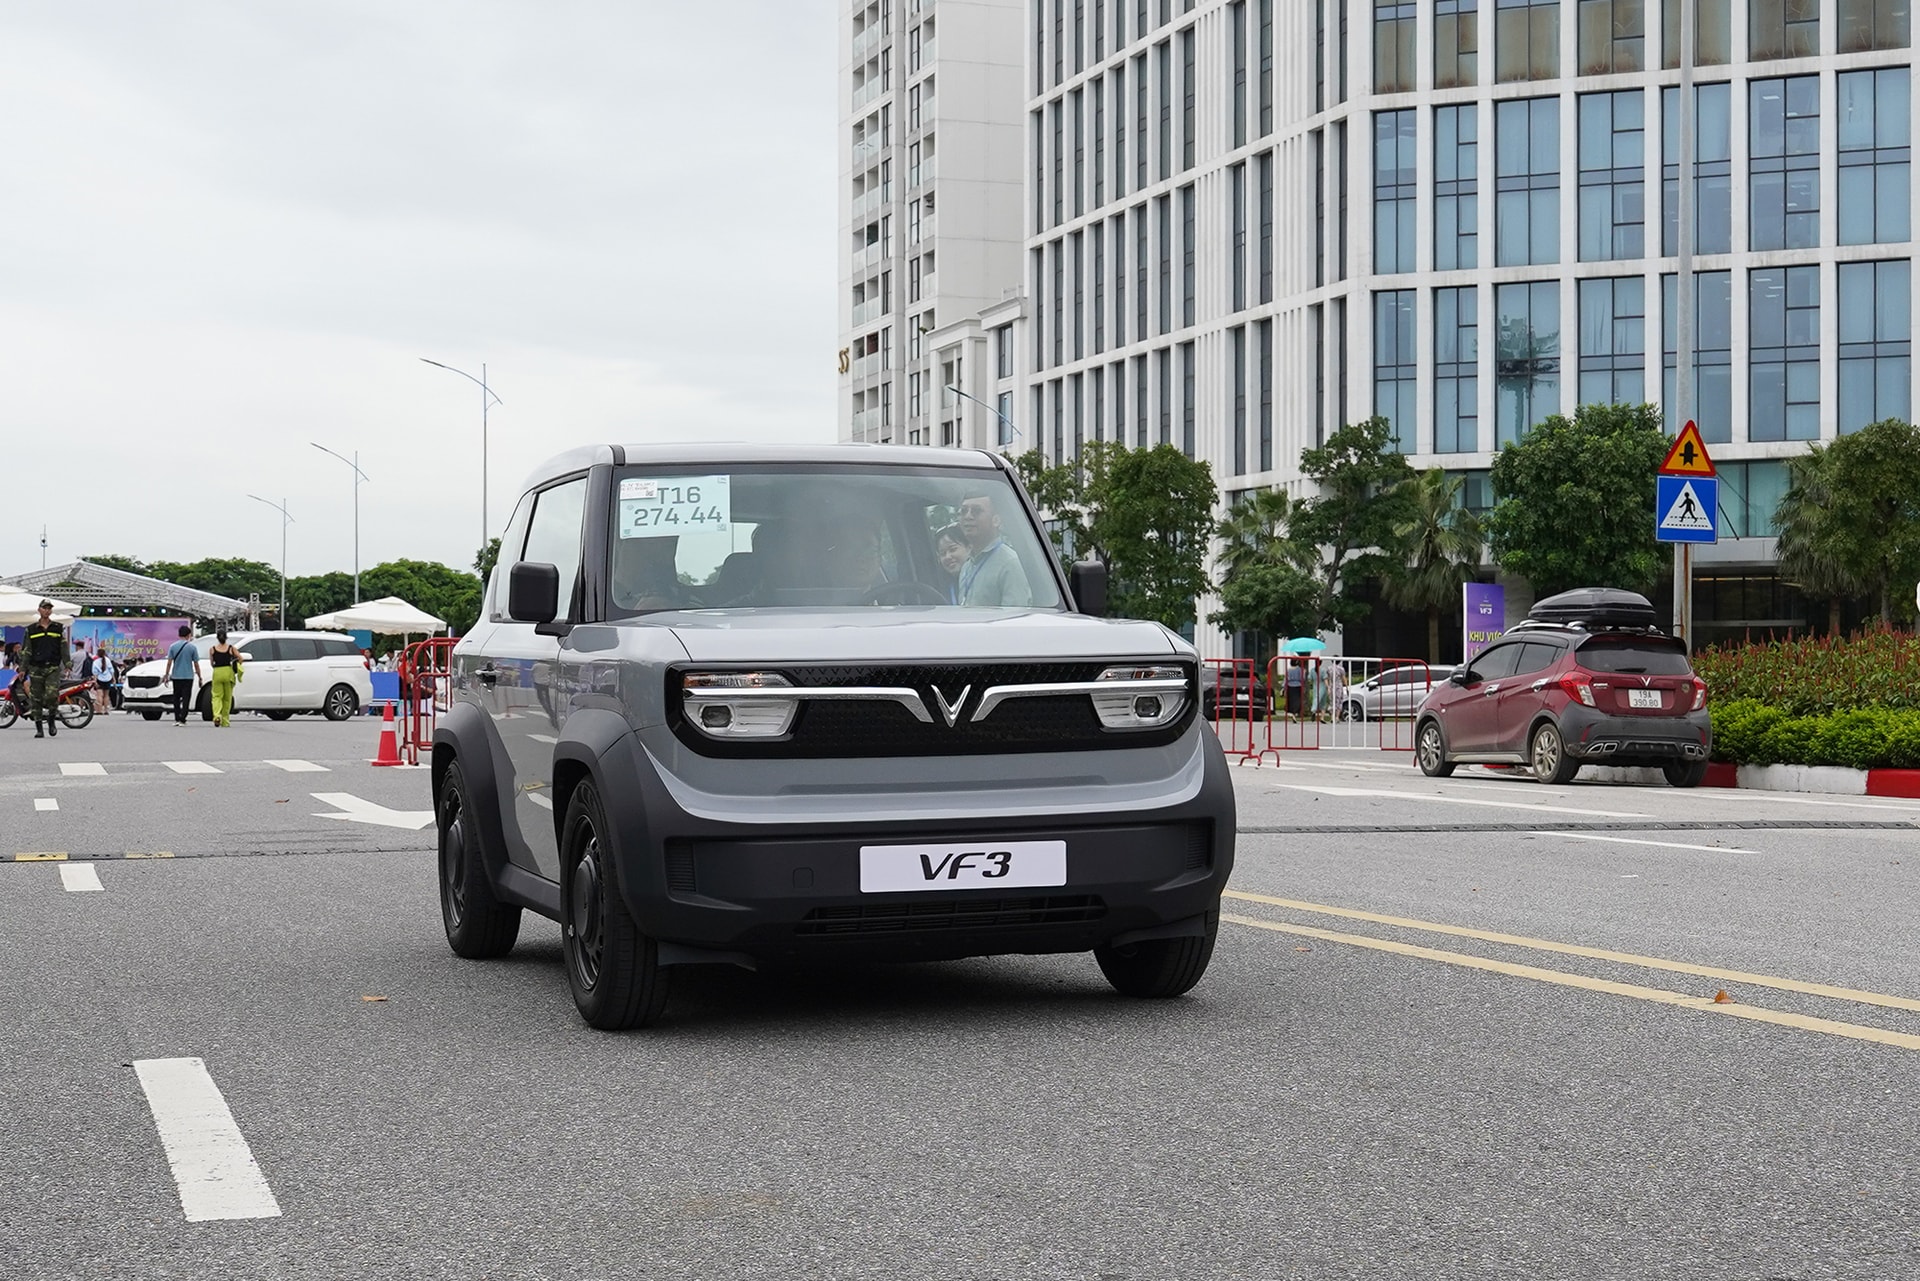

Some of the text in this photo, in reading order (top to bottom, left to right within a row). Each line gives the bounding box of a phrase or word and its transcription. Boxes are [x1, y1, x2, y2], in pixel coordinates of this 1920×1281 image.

[657, 486, 701, 505] T16
[634, 506, 723, 527] 274.44
[137, 638, 159, 646] GIAO
[1469, 631, 1485, 642] KHU
